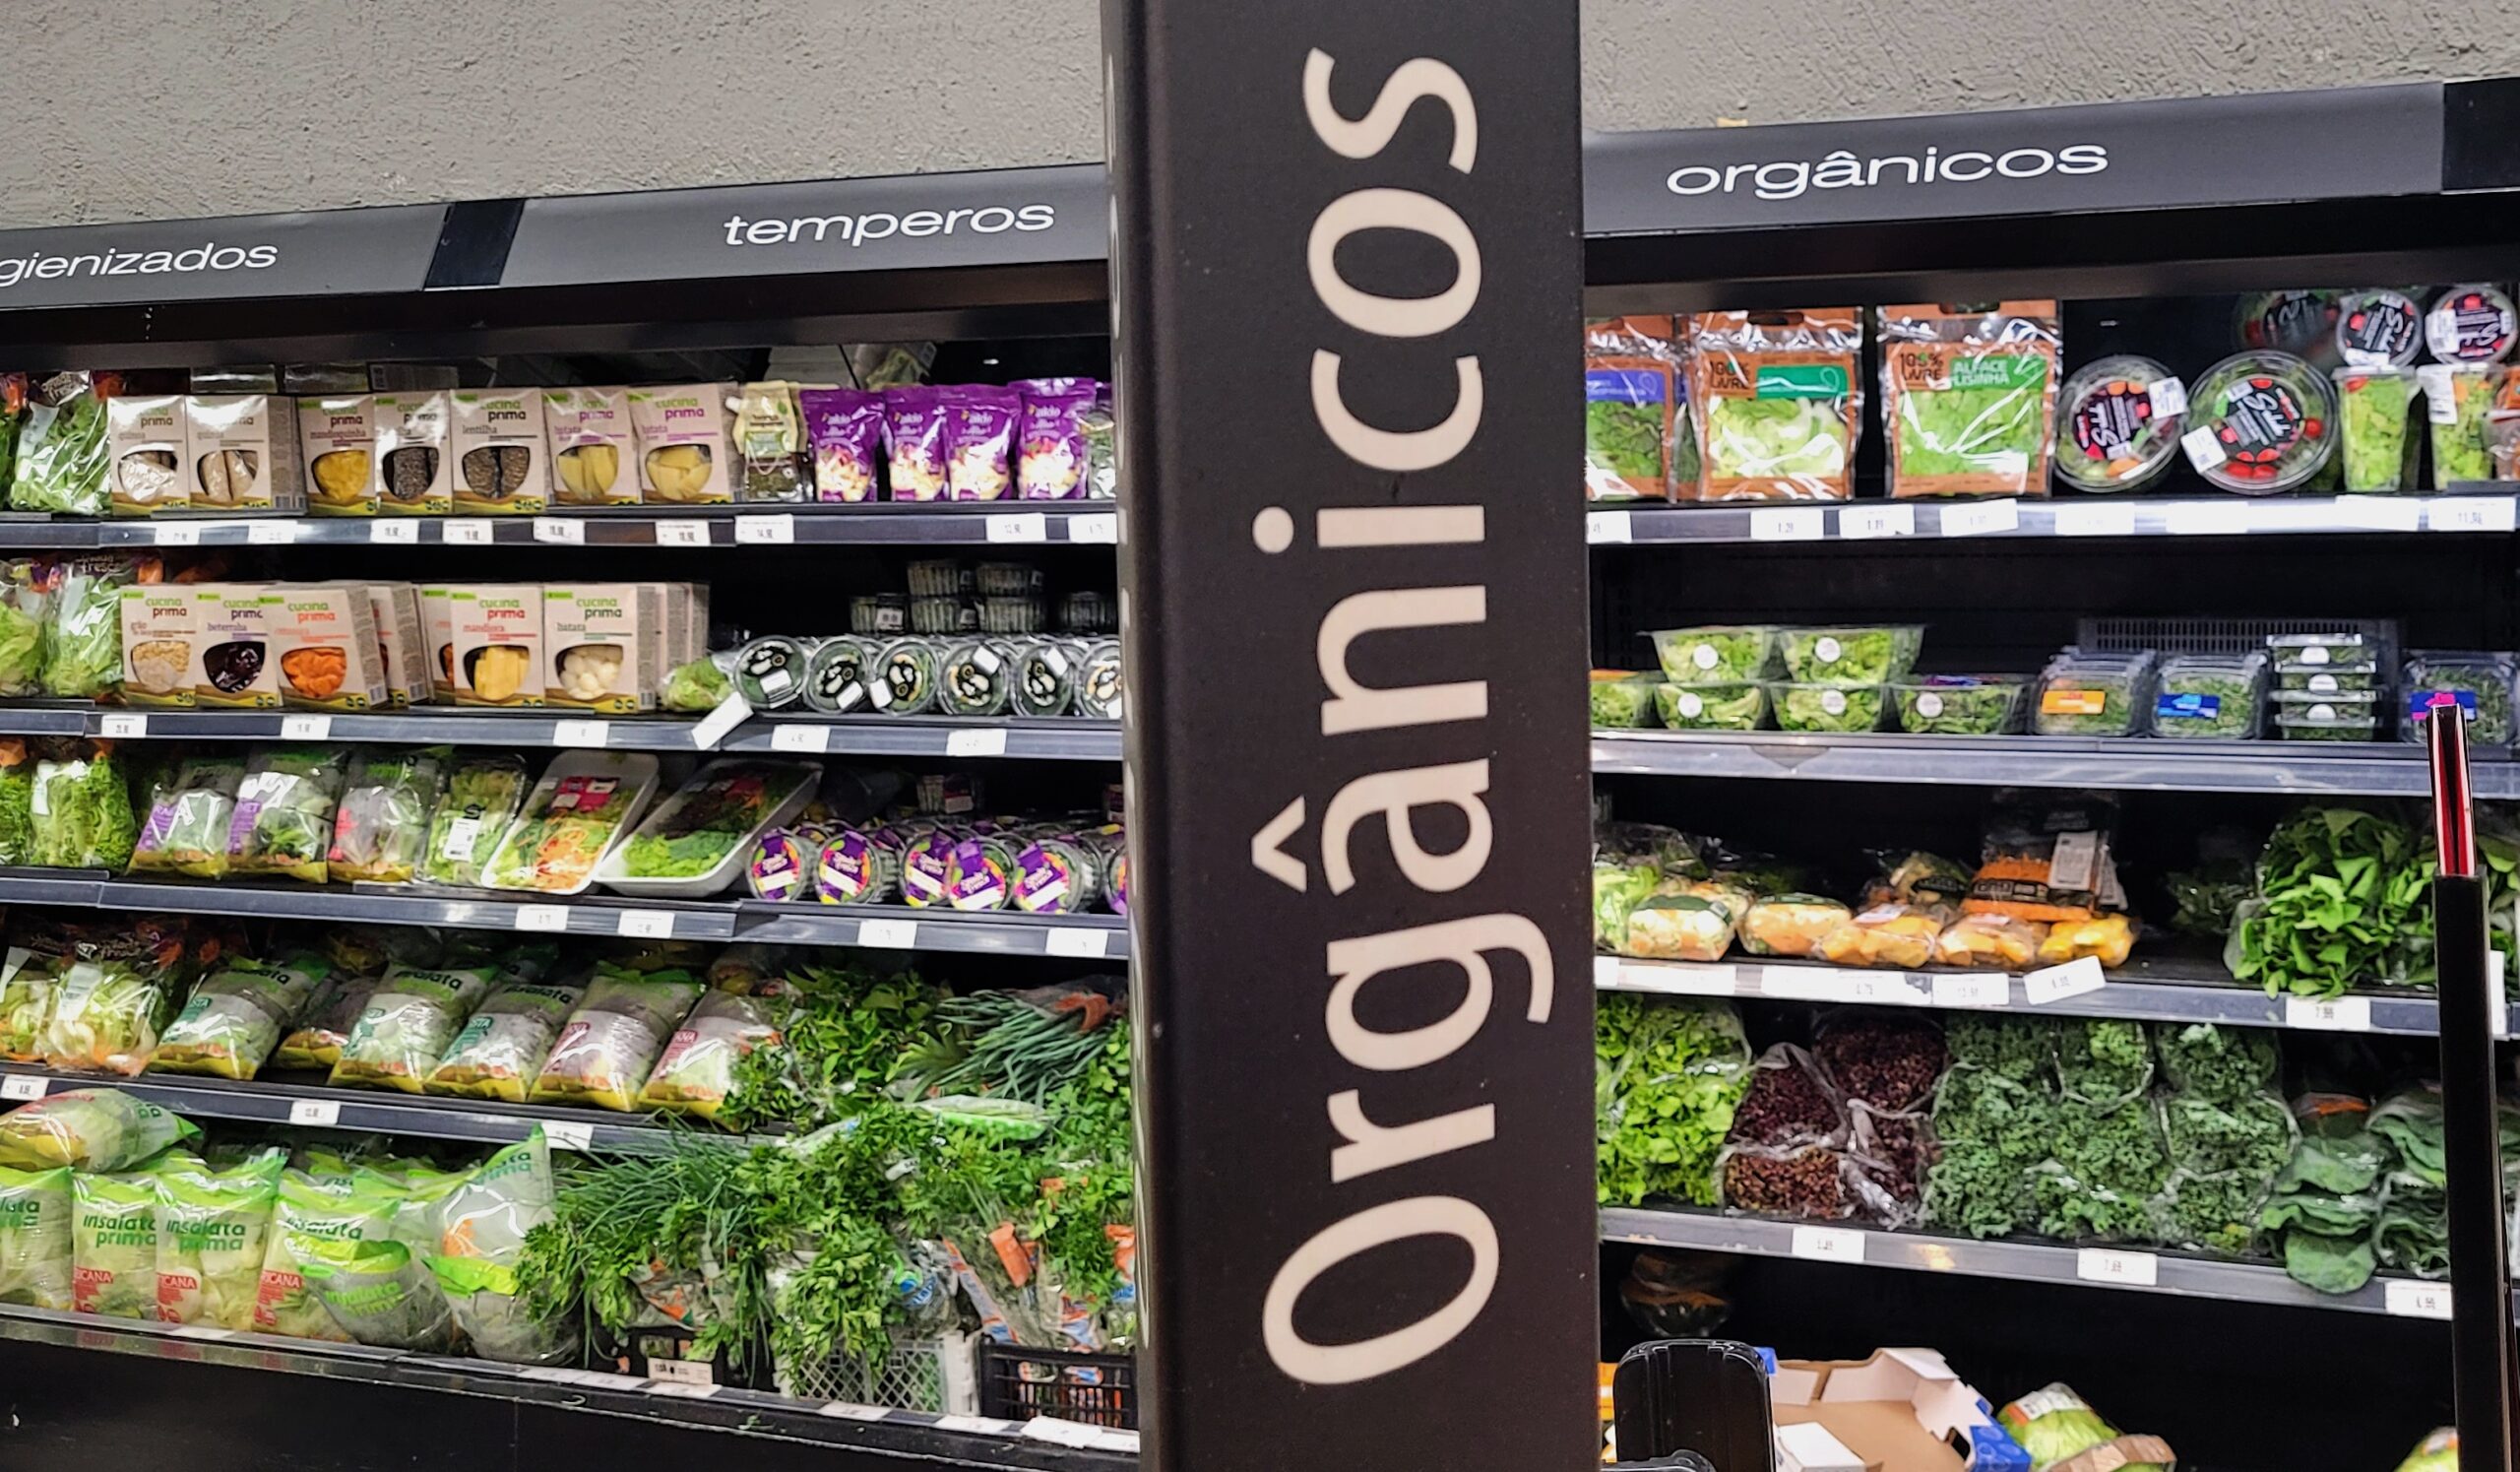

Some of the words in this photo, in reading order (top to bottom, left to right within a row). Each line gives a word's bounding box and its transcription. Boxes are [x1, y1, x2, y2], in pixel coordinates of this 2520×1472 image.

[1667, 144, 2109, 200] orgânicos
[724, 204, 1055, 247] temperos
[0, 242, 279, 288] gienizados
[488, 410, 527, 422] prima
[664, 408, 705, 421] prima
[141, 416, 173, 428] prima
[330, 416, 363, 428] prima
[145, 598, 182, 607] cucina
[288, 603, 329, 611] cucina
[479, 599, 521, 608] cucina
[576, 598, 618, 608] cucina
[153, 608, 187, 619] prima
[297, 612, 337, 623] prima
[487, 608, 526, 620] prima
[585, 608, 623, 620] prima
[1251, 47, 1554, 1384] Orgânicos
